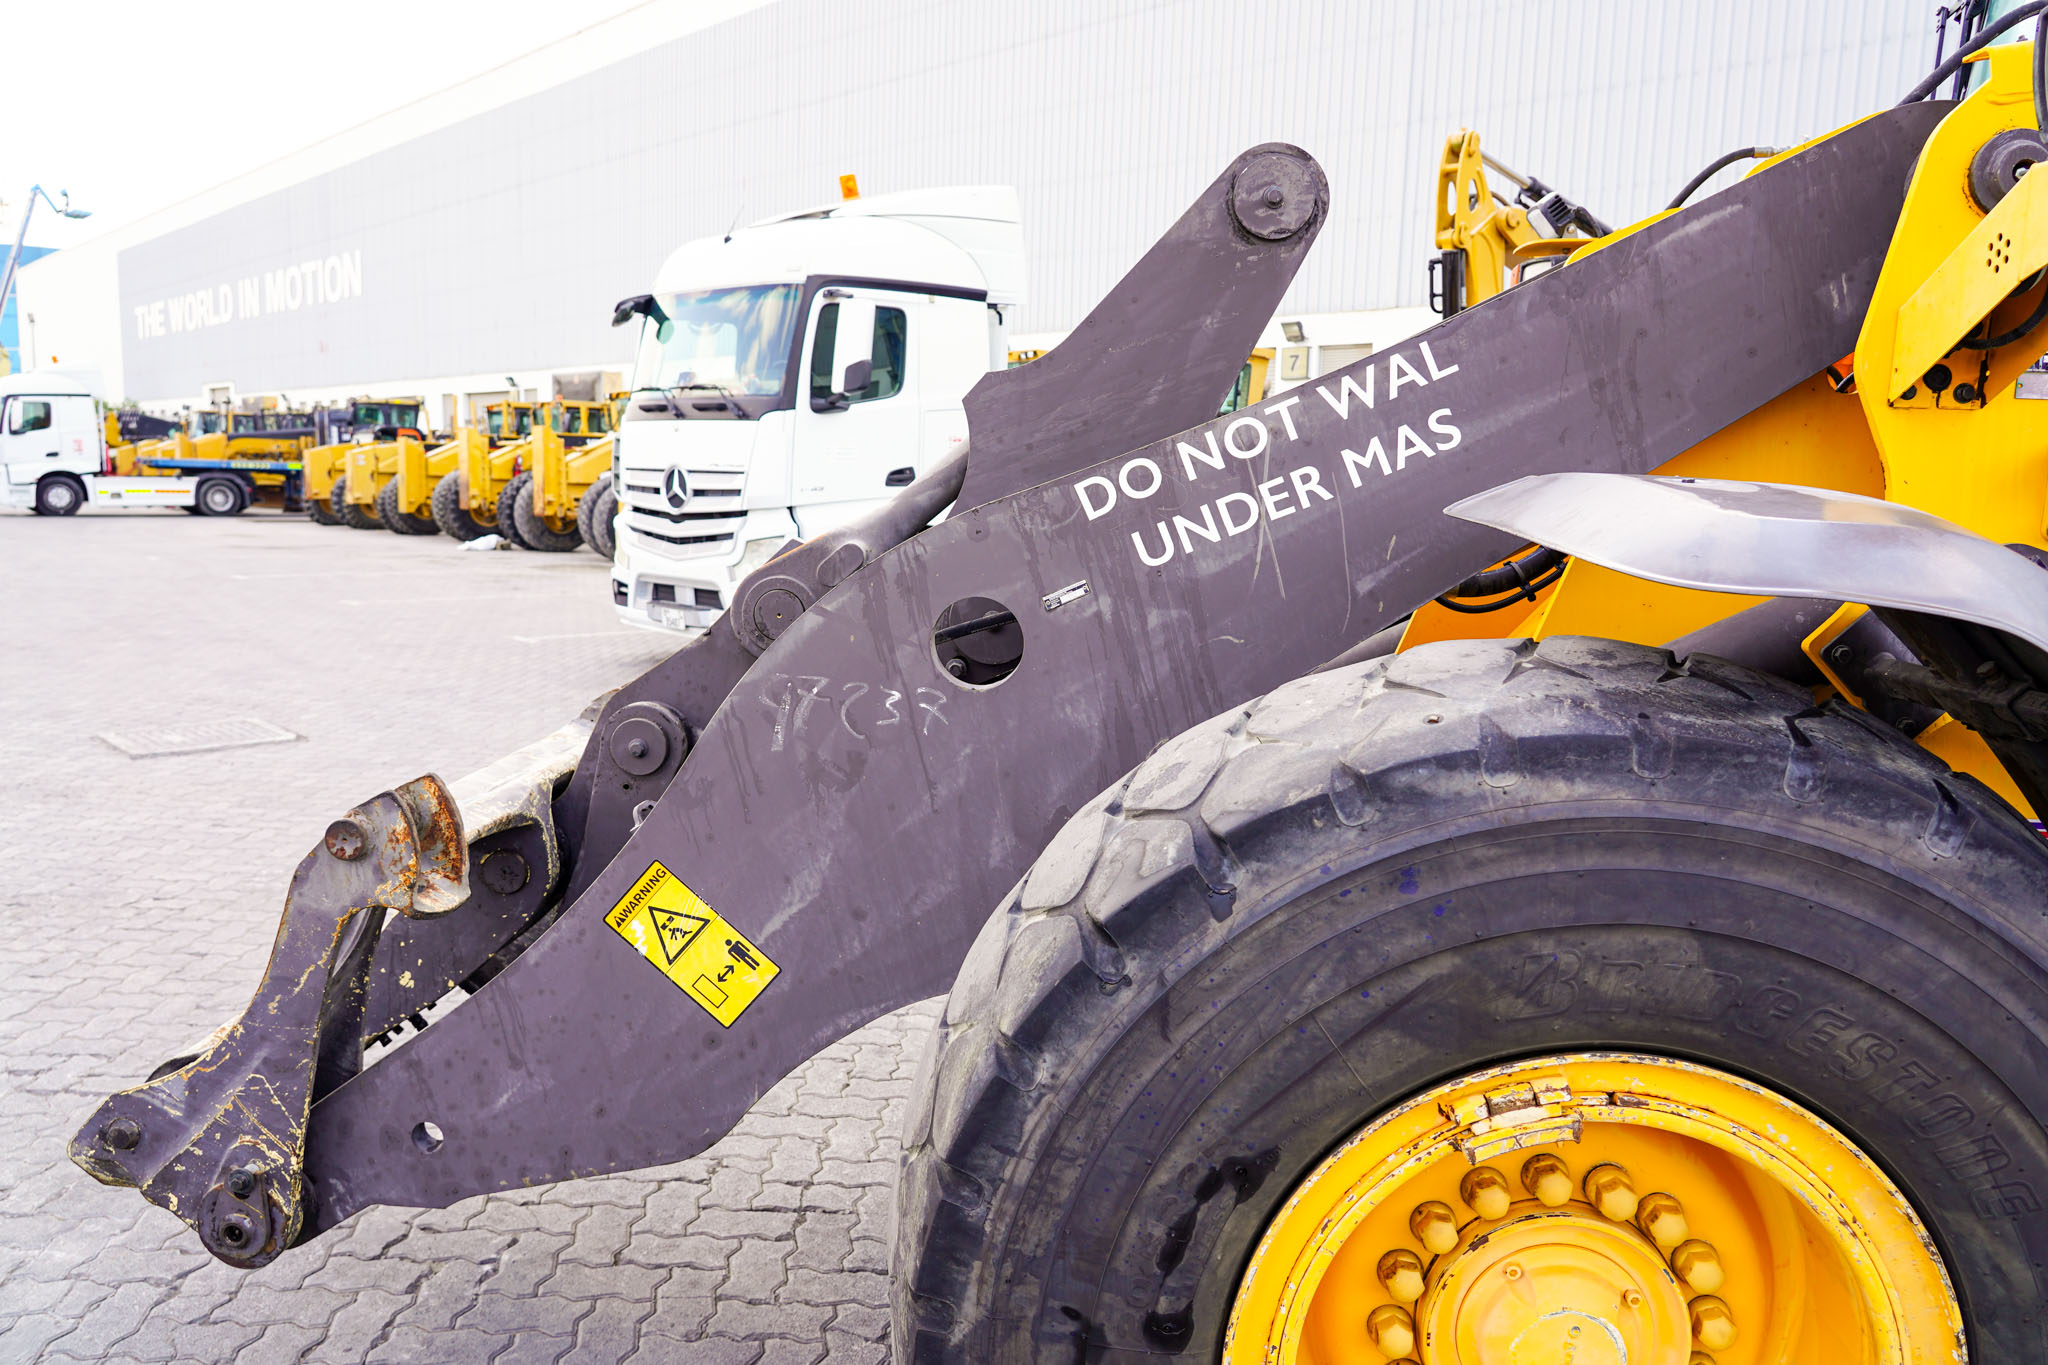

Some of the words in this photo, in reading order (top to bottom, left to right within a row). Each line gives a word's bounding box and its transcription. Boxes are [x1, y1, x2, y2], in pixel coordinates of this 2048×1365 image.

[134, 302, 165, 340] THE
[168, 284, 233, 334] WORLD
[238, 277, 260, 320] IN
[264, 250, 362, 314] MOTION
[1289, 354, 1300, 372] 7
[1074, 458, 1162, 521] DO
[1177, 397, 1300, 481] NOT
[1315, 341, 1459, 420] WAL
[1131, 466, 1334, 567] UNDER
[1341, 408, 1462, 488] MAS
[619, 868, 667, 922] WARNING
